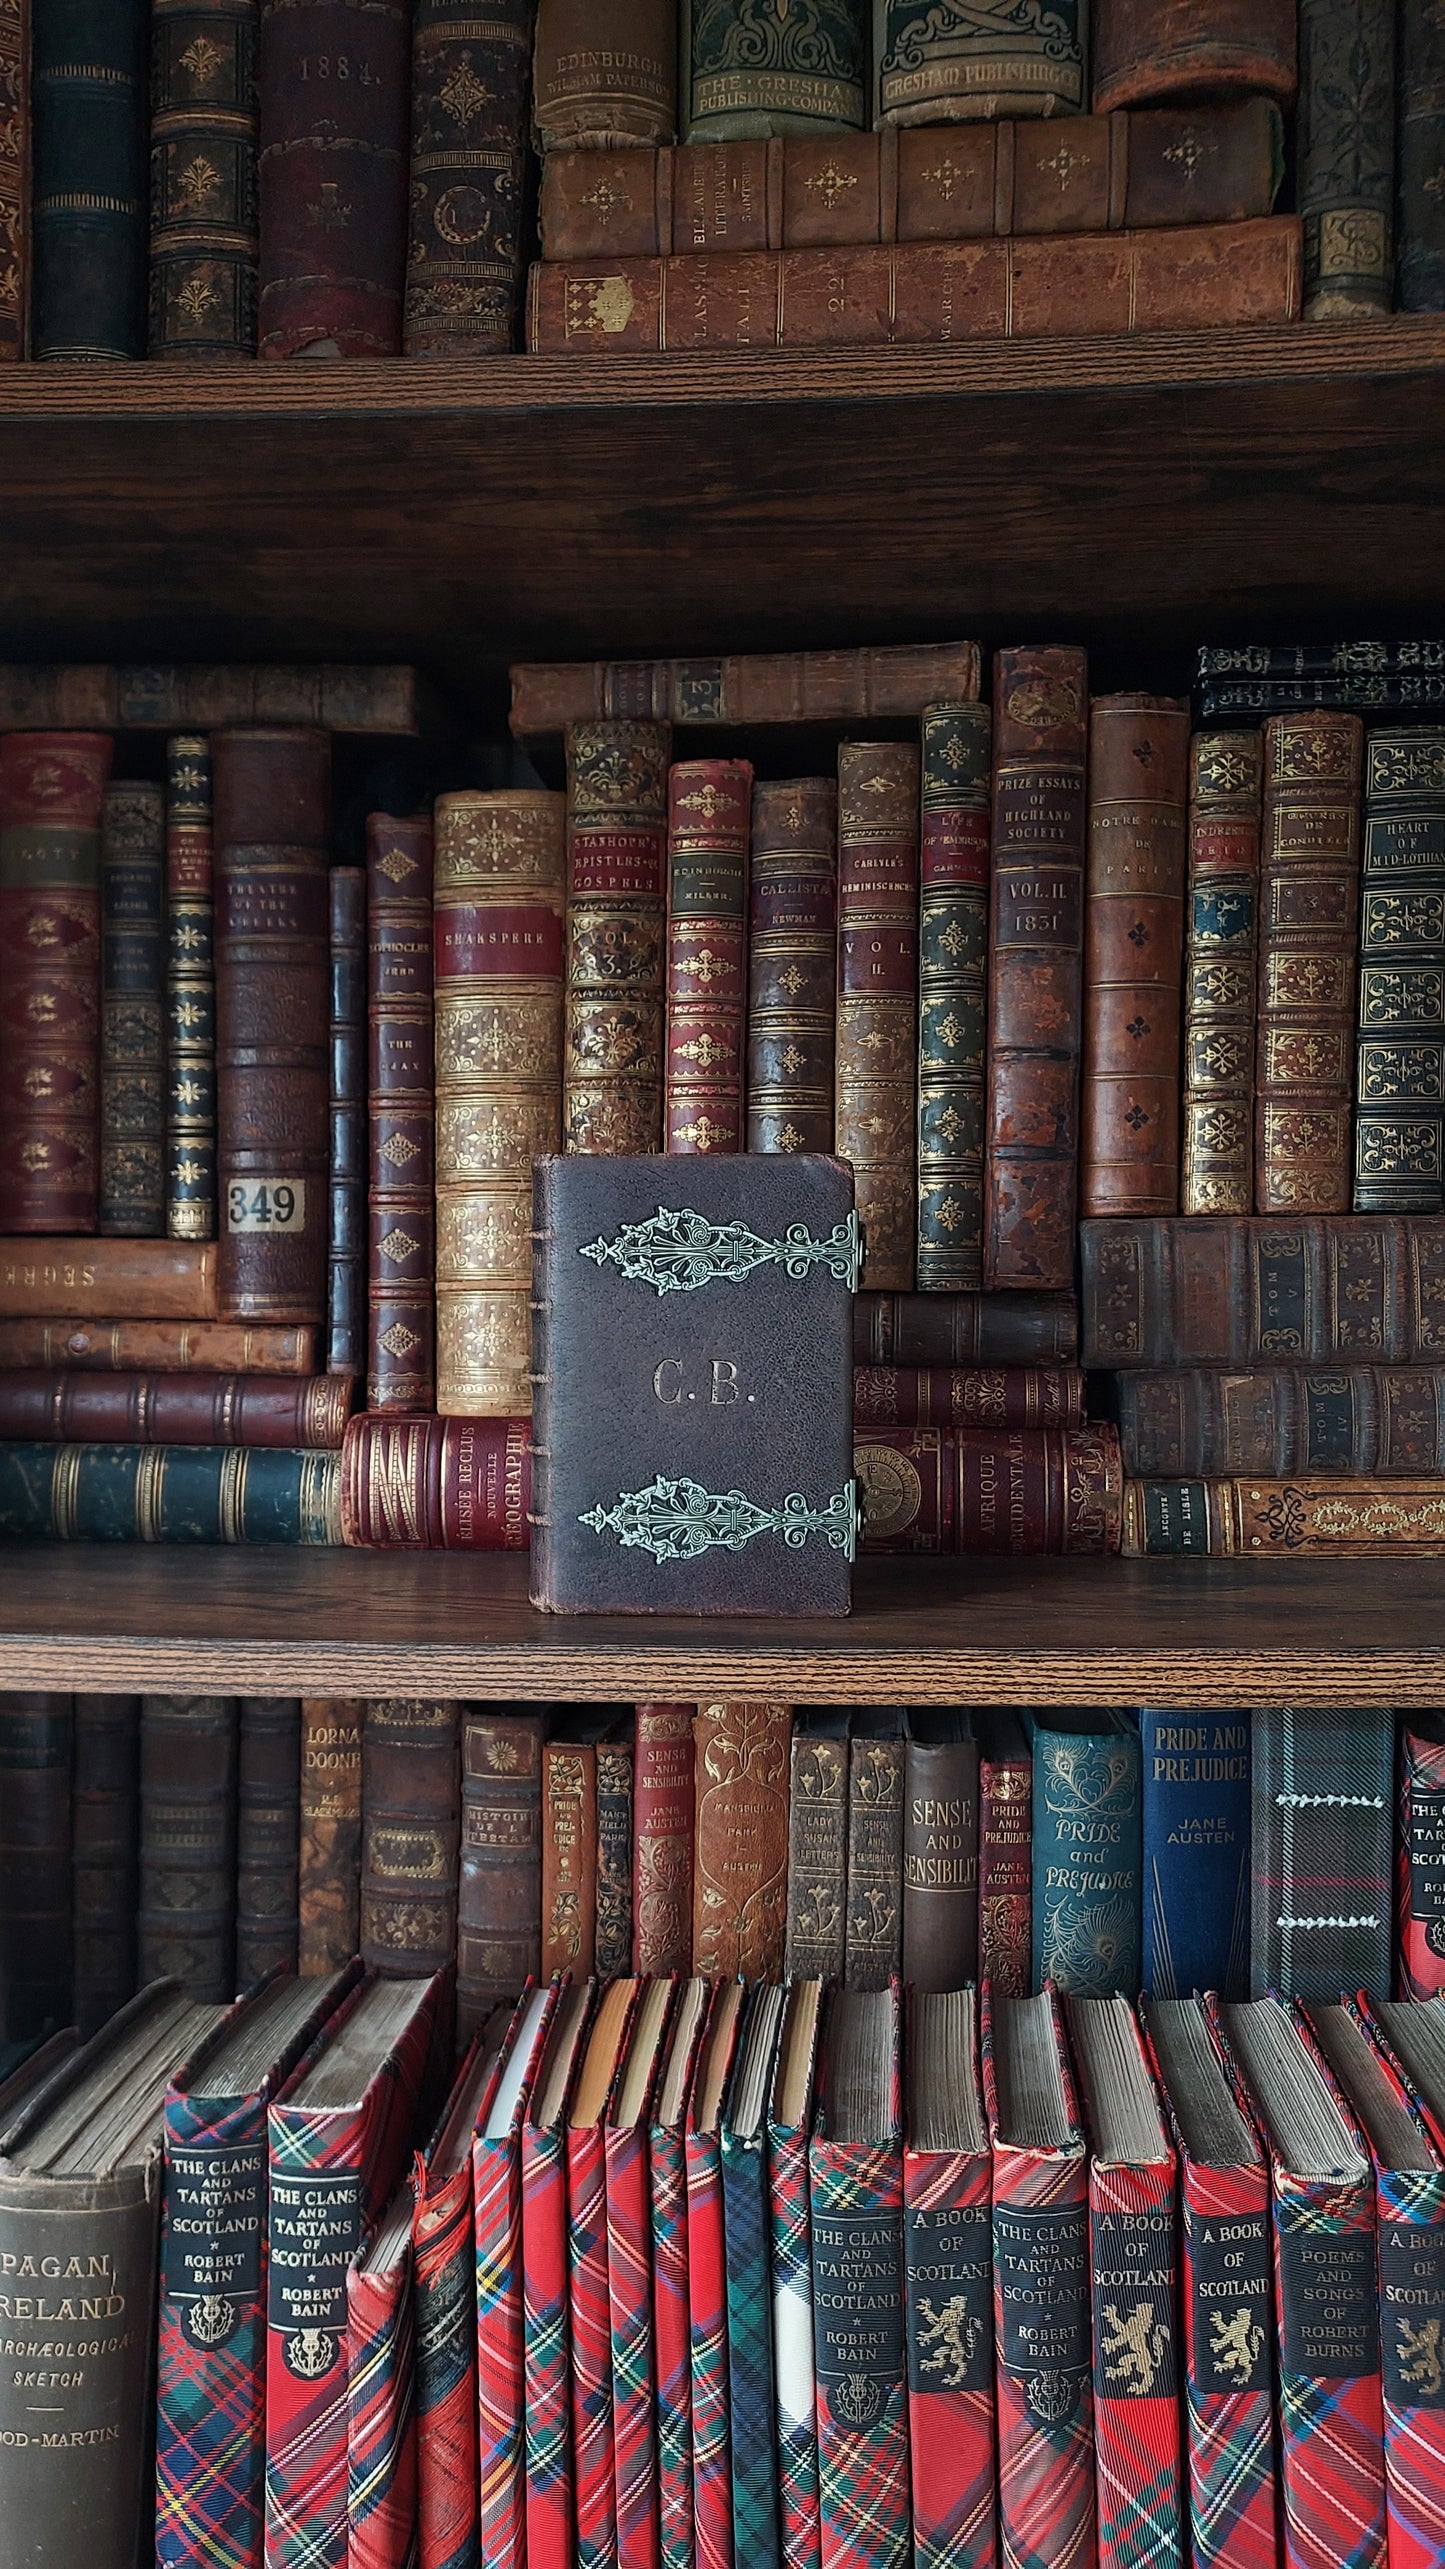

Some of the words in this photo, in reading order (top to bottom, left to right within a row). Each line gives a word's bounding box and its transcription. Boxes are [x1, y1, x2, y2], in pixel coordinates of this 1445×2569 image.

[556, 51, 663, 77] EDINBURGH
[699, 75, 742, 97] THE
[885, 68, 959, 99] GRESHAM
[998, 778, 1032, 791] PRIZE
[1038, 777, 1081, 791] ESSAYS
[1030, 795, 1046, 805] OF
[1005, 810, 1071, 823] HIGHLAND
[1092, 817, 1140, 829] NOTRE
[1008, 828, 1065, 839] SOCIETY
[1387, 822, 1430, 835] HEART
[923, 837, 937, 846] OF
[1397, 838, 1418, 849] OF
[854, 854, 904, 869] CARLYLE'S
[574, 877, 653, 889] GOSPELS
[589, 930, 639, 945] VOL.
[230, 1185, 295, 1224] 349
[459, 1426, 475, 1484] RECLUS
[487, 1452, 497, 1519] NOUVELLE
[980, 1453, 996, 1536] AFRIQUE
[1180, 1487, 1191, 1520] LISLE
[1182, 1530, 1191, 1545] DE
[306, 1727, 360, 1744] LORNA
[1155, 1726, 1206, 1750] PRIDE
[1214, 1726, 1247, 1750] AND
[647, 1749, 686, 1762] SENSE
[655, 1764, 678, 1774] AND
[1152, 1756, 1248, 1782] PREJUDICE
[911, 1798, 972, 1828] SENSE
[992, 1806, 1026, 1817] PRIDE
[1411, 1804, 1438, 1817] THE
[807, 1817, 832, 1827] LADY
[998, 1820, 1020, 1829] AND
[1178, 1818, 1227, 1830] JANE
[985, 1831, 1032, 1844] PREJUDICE
[1055, 1819, 1121, 1843] PRIDE
[1167, 1832, 1236, 1844] AUSTEN
[925, 1834, 962, 1850] AND
[1069, 1848, 1108, 1864] and
[172, 2159, 204, 2175] THE
[209, 2156, 262, 2174] CLANS
[201, 2177, 232, 2188] AND
[177, 2187, 256, 2205] TARTANS
[271, 2186, 301, 2203] THE
[304, 2187, 358, 2203] CLANS
[205, 2207, 224, 2217] OF
[297, 2207, 327, 2219] AND
[912, 2214, 927, 2228] A
[935, 2206, 987, 2226] BOOK
[172, 2216, 259, 2234] SCOTLAND
[274, 2219, 352, 2235] TARTANS
[1098, 2216, 1116, 2231] A
[1122, 2215, 1174, 2231] BOOK
[813, 2229, 844, 2246] THE
[849, 2229, 899, 2247] CLANS
[998, 2223, 1031, 2241] THE
[1036, 2222, 1087, 2241] CLANS
[1202, 2230, 1216, 2244] A
[1220, 2223, 1264, 2240] BOOK
[302, 2239, 321, 2250] OF
[938, 2237, 964, 2251] OF
[1390, 2231, 1405, 2248] A
[840, 2249, 872, 2260] AND
[1029, 2244, 1060, 2255] AND
[1124, 2243, 1149, 2257] OF
[1301, 2250, 1365, 2263] POEMS
[183, 2253, 245, 2269] ROBERT
[271, 2249, 355, 2266] SCOTLAND
[1004, 2253, 1085, 2272] TARTANS
[1223, 2252, 1246, 2267] OF
[1, 2253, 110, 2279] PAGAN
[816, 2260, 898, 2276] TARTANS
[1413, 2261, 1436, 2276] OF
[193, 2269, 233, 2283] BAIN
[1037, 2275, 1056, 2287] OF
[1316, 2270, 1352, 2282] AND
[281, 2286, 342, 2302] ROBERT
[847, 2281, 866, 2292] OF
[1199, 2278, 1270, 2297] SCOTLAND
[1303, 2287, 1365, 2300] SONGS
[1003, 2285, 1088, 2304] SCOTLAND
[0, 2295, 126, 2321] RELAND
[290, 2303, 331, 2317] BAIN
[1323, 2307, 1347, 2320] OF
[825, 2330, 889, 2345] ROBERT
[1017, 2324, 1078, 2340] ROBERT
[1301, 2325, 1369, 2338] ROBERT
[837, 2348, 877, 2360] BAIN
[1028, 2343, 1068, 2357] BAIN
[1305, 2344, 1365, 2358] BURNS
[13, 2371, 84, 2387] SKETCH
